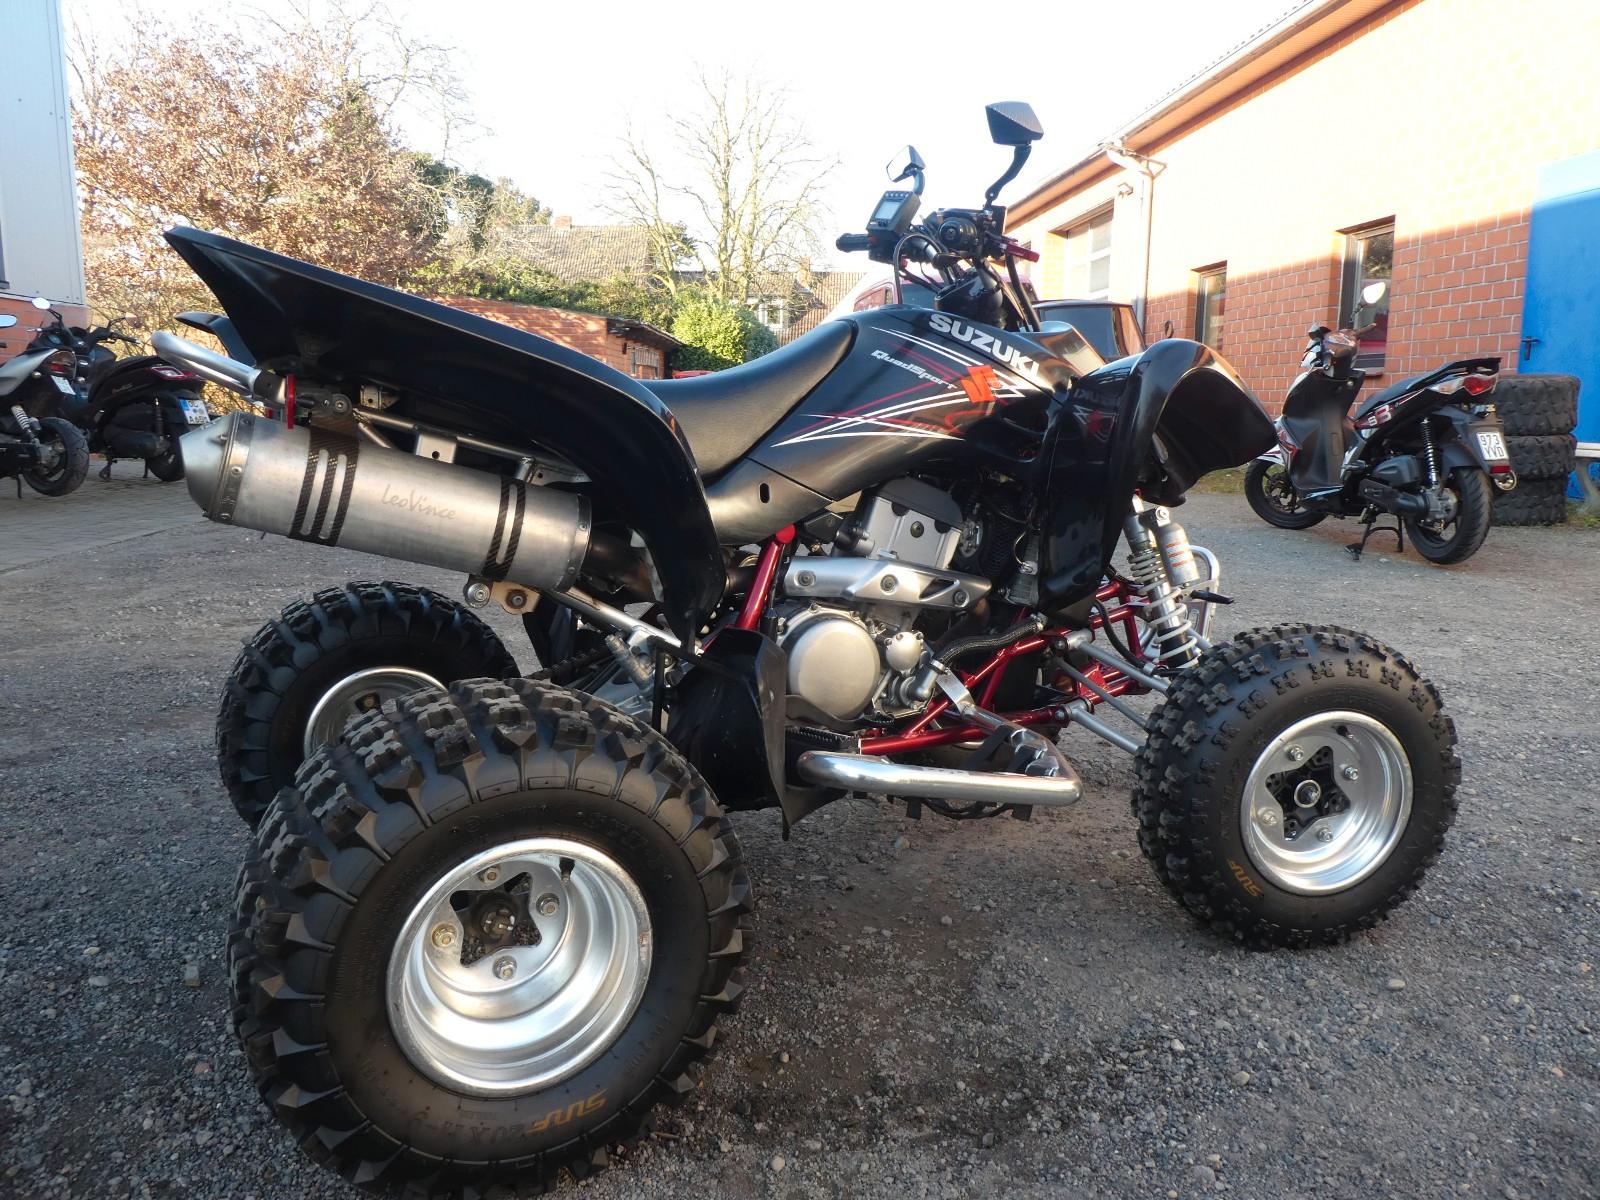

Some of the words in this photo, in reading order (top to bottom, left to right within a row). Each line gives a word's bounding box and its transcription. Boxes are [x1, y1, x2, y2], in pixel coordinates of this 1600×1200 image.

[928, 313, 1040, 378] SUZUKI
[870, 349, 958, 389] QuadSport
[1480, 434, 1500, 446] 973
[381, 483, 456, 520] LeoVince
